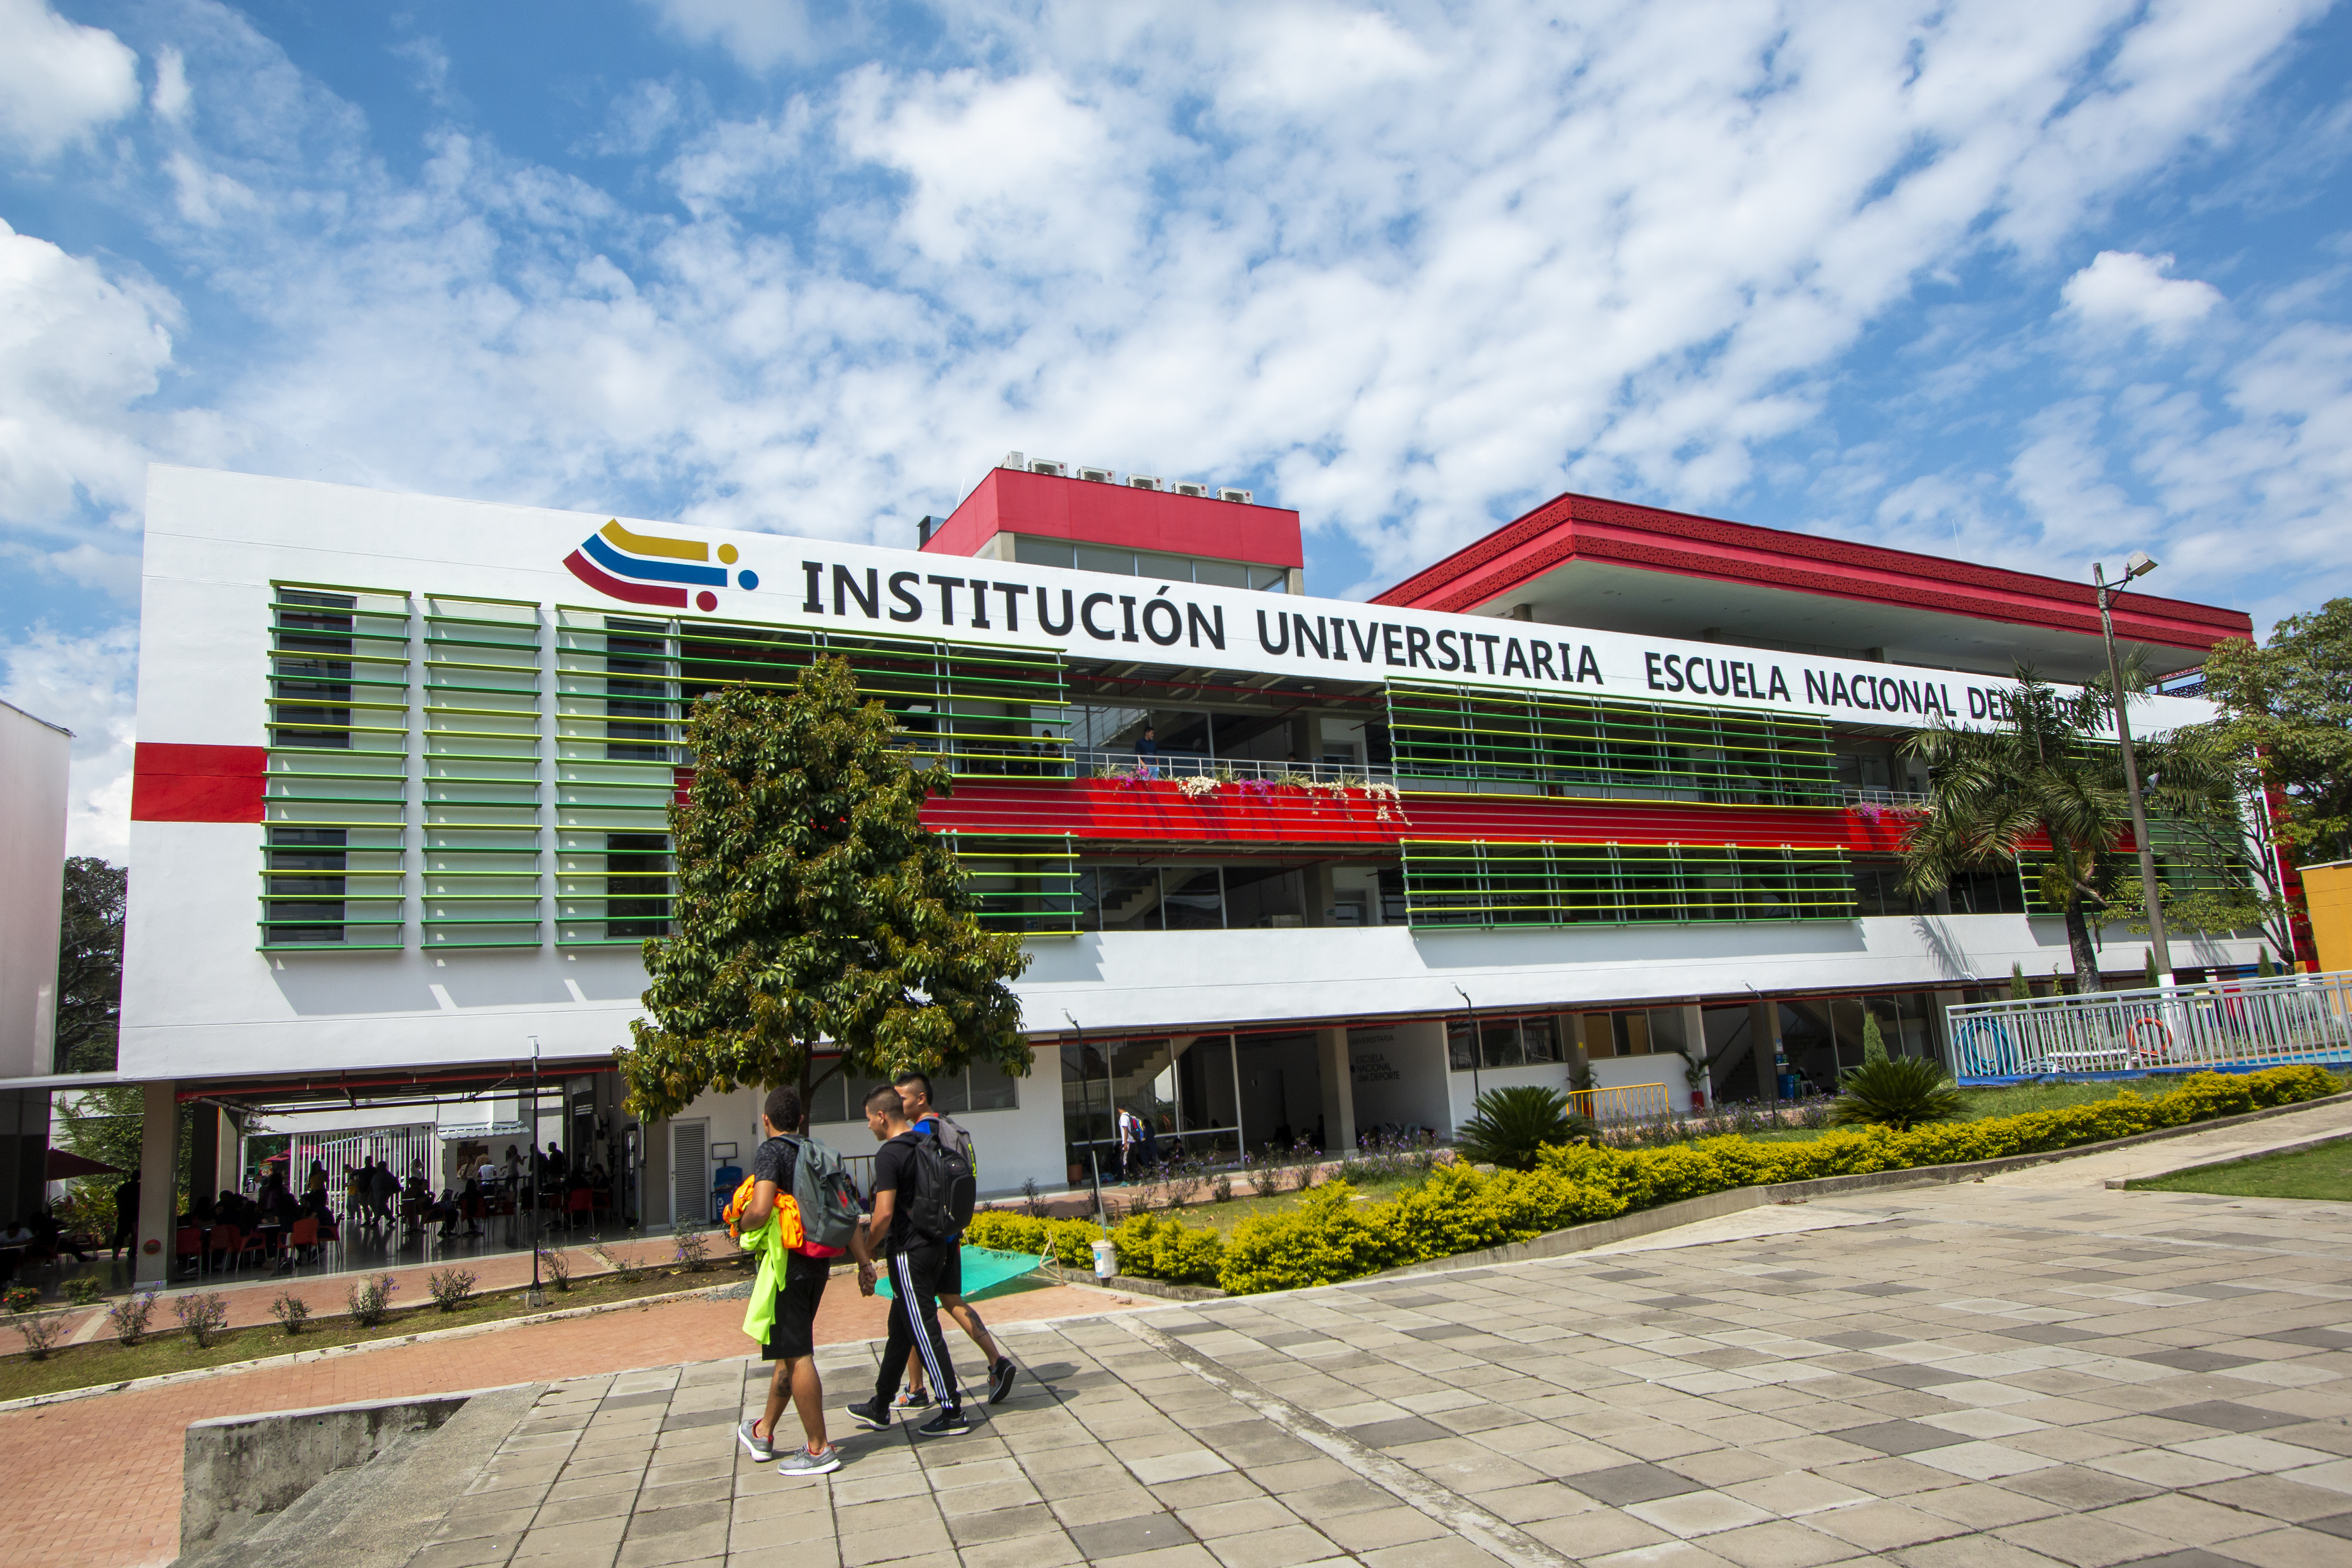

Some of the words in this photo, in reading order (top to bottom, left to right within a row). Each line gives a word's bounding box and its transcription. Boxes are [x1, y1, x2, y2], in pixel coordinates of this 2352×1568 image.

[802, 560, 1225, 650] INSTITUCIÓN
[1256, 609, 1604, 685] UNIVERSITARIA
[1645, 652, 1792, 702] ESCUELA
[1804, 669, 1957, 717] NACIONAL
[1349, 1035, 1393, 1045] UNIVERSITARIA
[1356, 1054, 1384, 1064] ESCUELA
[1357, 1063, 1392, 1073] NACIONAL
[1358, 1074, 1369, 1082] del
[1370, 1071, 1400, 1081] DEPORTE
